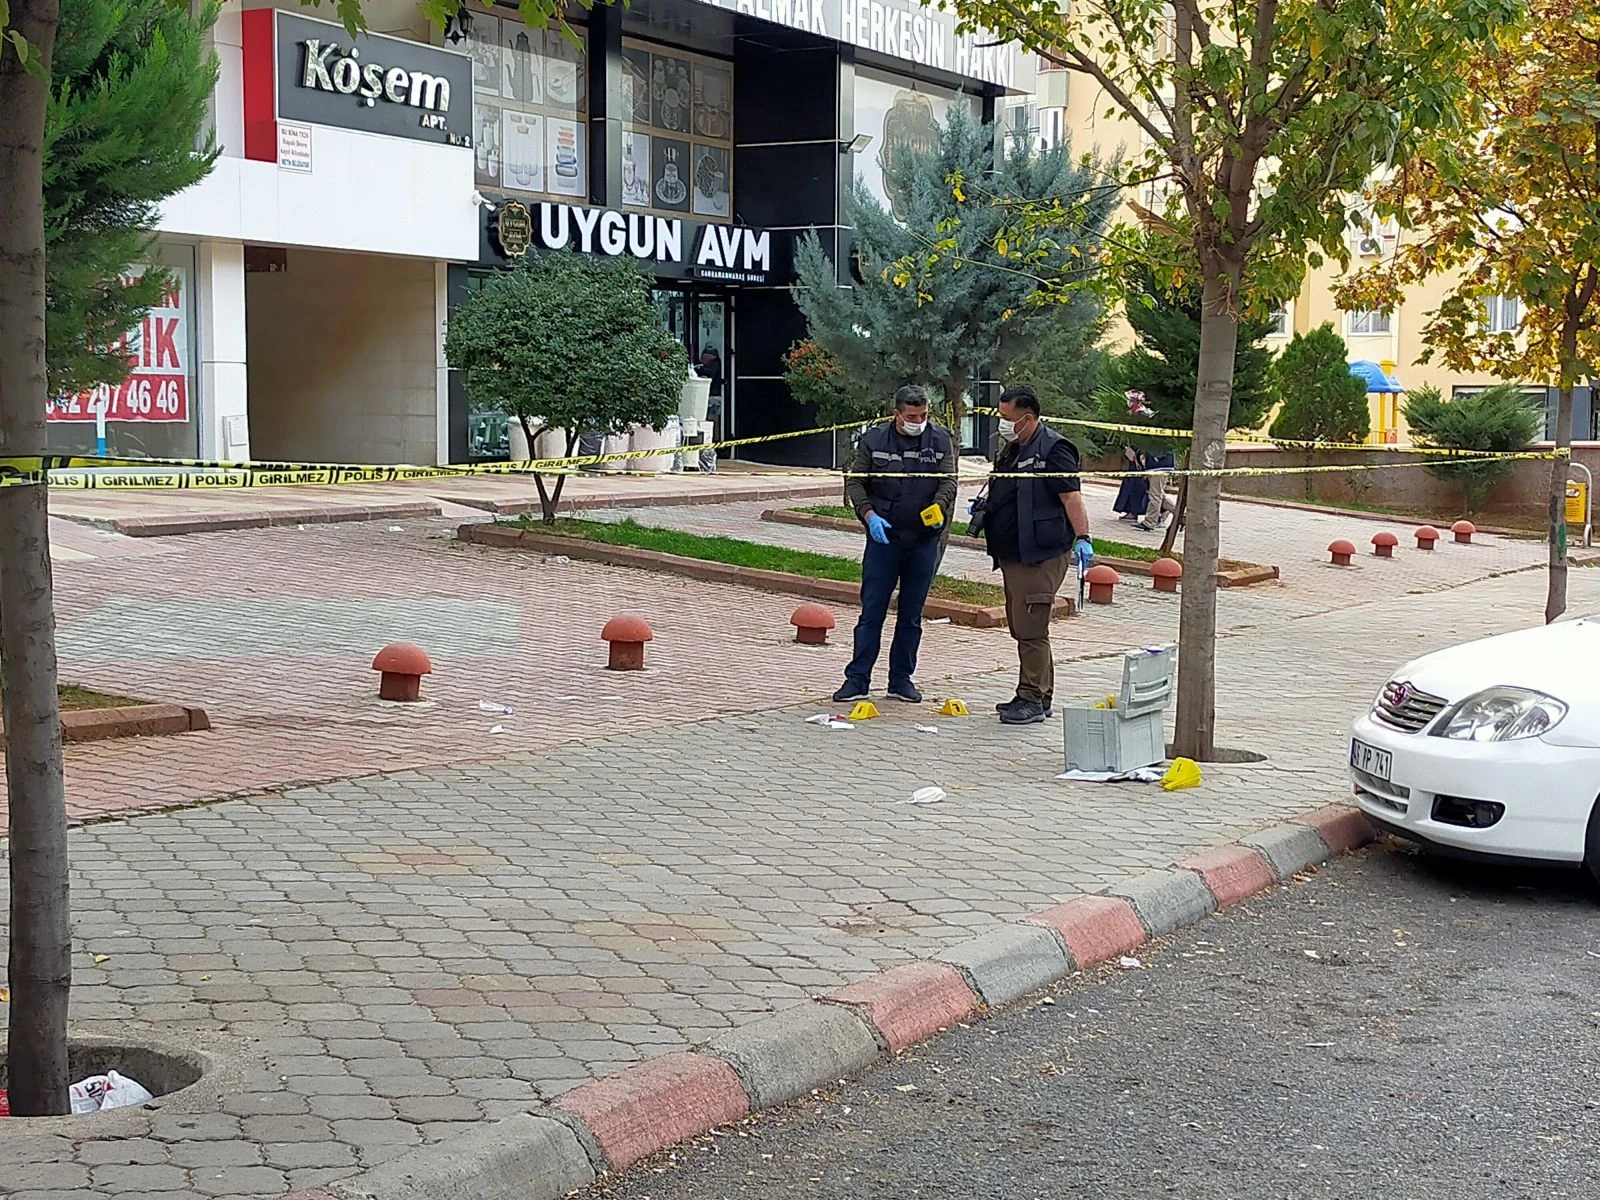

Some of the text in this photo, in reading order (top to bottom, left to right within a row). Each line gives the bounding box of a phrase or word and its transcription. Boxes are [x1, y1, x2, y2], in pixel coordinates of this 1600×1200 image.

[841, 0, 945, 69] HERKESİN
[304, 39, 451, 112] Köşem
[421, 114, 448, 130] APT.
[541, 202, 770, 271] UYGUN AVM
[126, 379, 151, 414] 46
[156, 380, 179, 414] 46
[48, 475, 79, 486] OLİS
